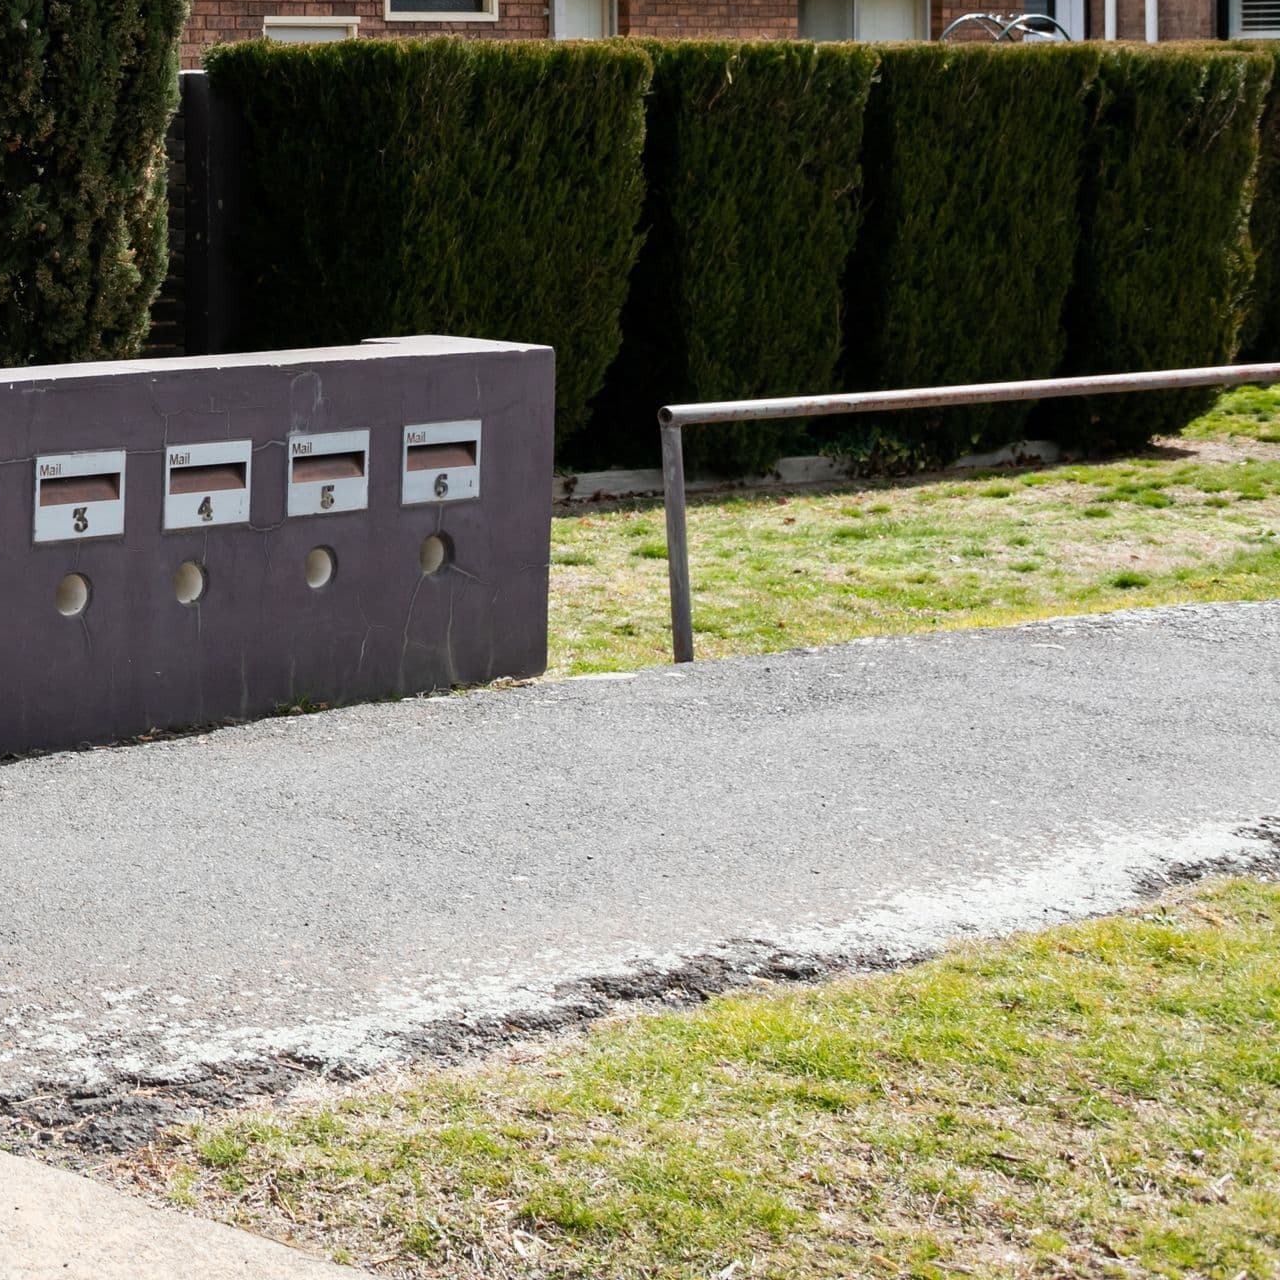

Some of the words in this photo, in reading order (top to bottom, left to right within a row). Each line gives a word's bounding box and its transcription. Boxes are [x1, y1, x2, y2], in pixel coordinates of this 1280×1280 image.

[406, 431, 427, 443] Mail
[292, 442, 313, 455] Mail
[169, 453, 191, 465] Mail
[40, 464, 62, 476] Mail
[433, 473, 449, 498] 6
[320, 485, 335, 509] 5
[197, 496, 213, 522] 4
[72, 507, 89, 533] 3
